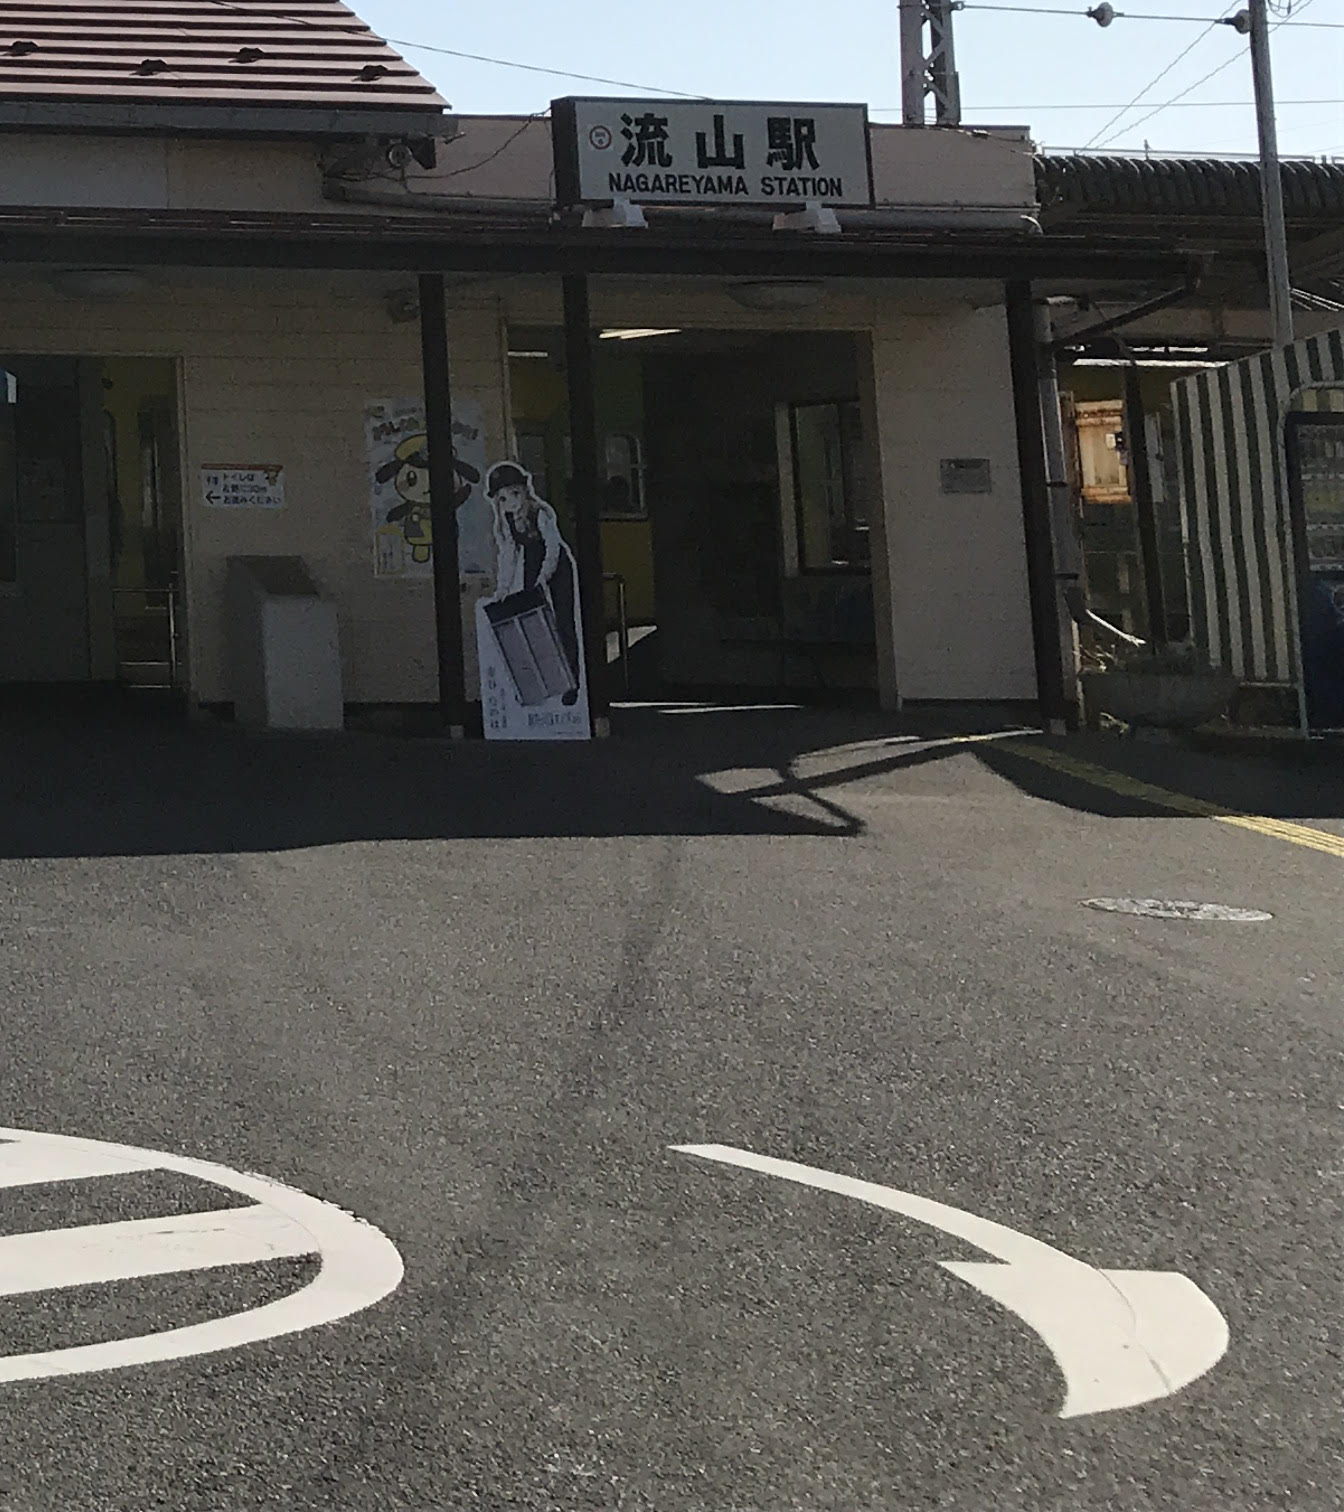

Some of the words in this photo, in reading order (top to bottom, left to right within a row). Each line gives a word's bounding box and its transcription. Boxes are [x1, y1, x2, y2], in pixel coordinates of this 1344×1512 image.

[620, 113, 820, 171] 流山駅
[609, 172, 750, 196] NAGAREYAMA
[761, 176, 844, 198] STATION
